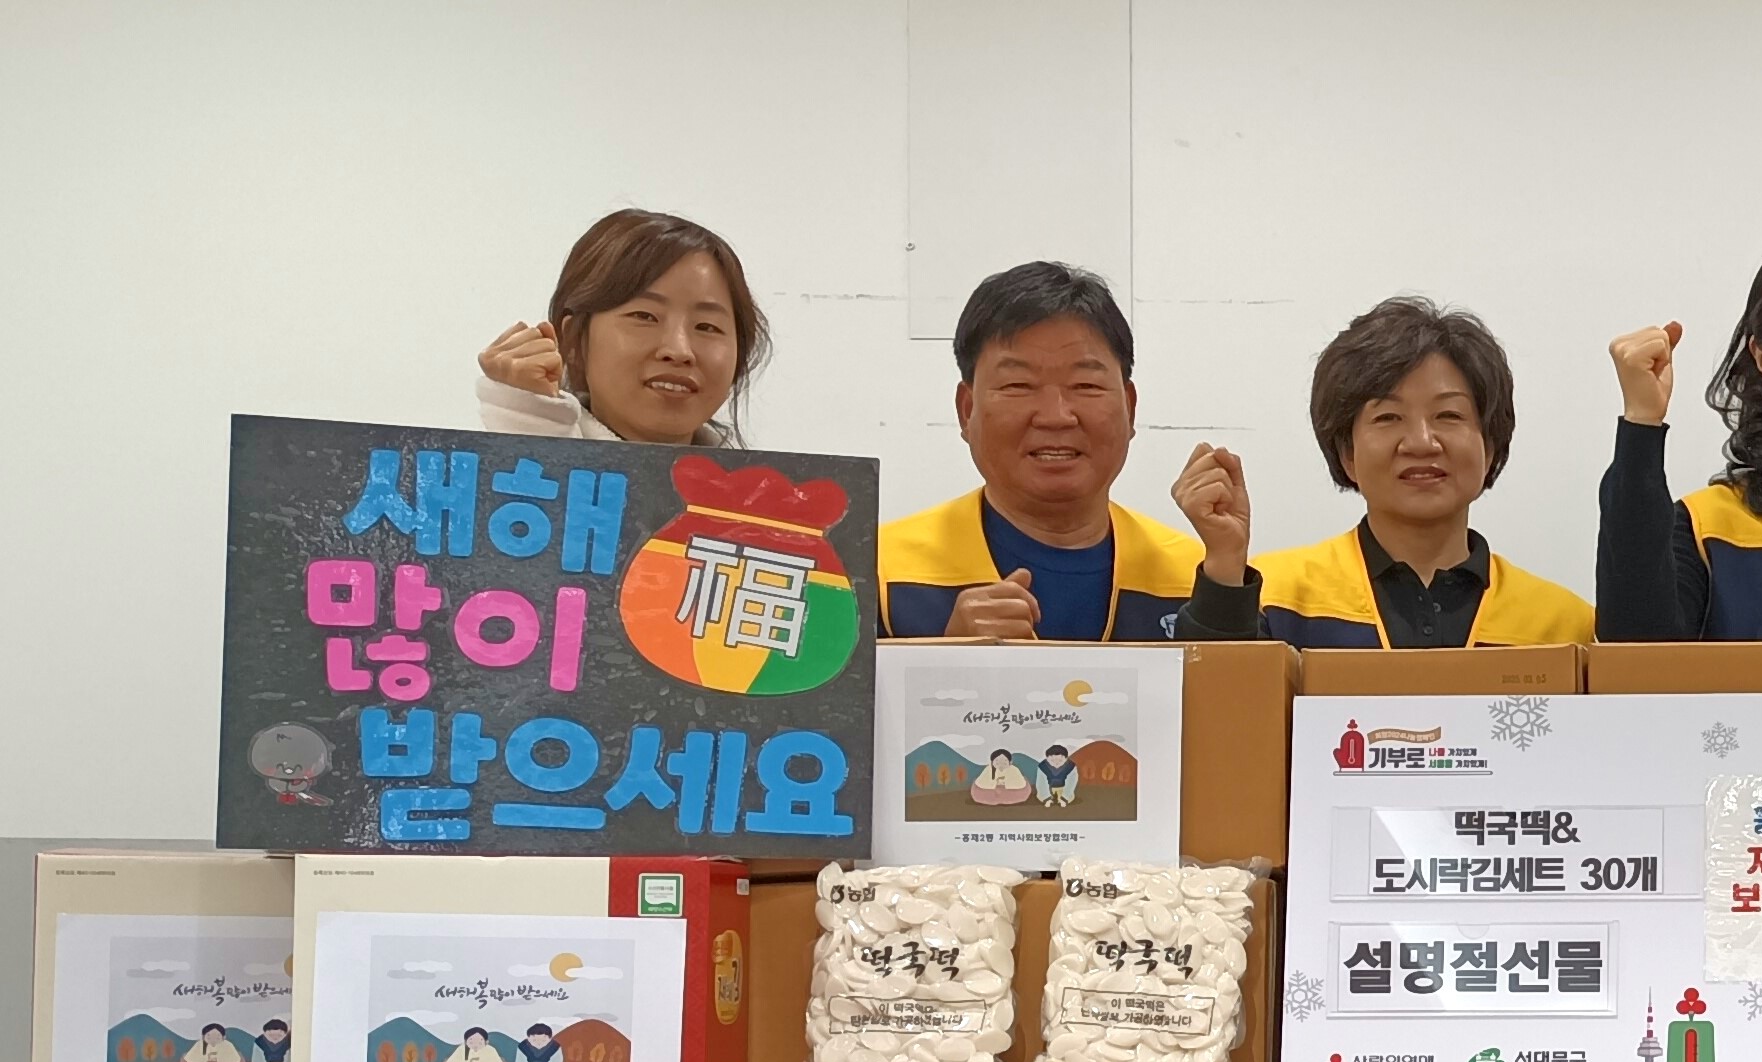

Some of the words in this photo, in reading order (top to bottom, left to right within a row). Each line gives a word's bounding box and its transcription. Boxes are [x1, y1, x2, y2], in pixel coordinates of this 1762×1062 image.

[342, 449, 627, 575] 새해
[676, 534, 816, 658] 福
[305, 559, 587, 701] 많이
[358, 706, 855, 842] 받으세요
[1368, 748, 1425, 768] 기부로
[1455, 811, 1580, 844] 떡국떡&
[848, 885, 876, 902] 농협
[1086, 882, 1117, 899] 농협
[1373, 857, 1566, 893] 도시락김세트
[1580, 857, 1659, 893] 30개
[860, 941, 960, 980] 떡국떡
[1095, 939, 1193, 978] 떡국떡
[1344, 940, 1603, 993] 설명절선물
[253, 983, 292, 998] 받으세
